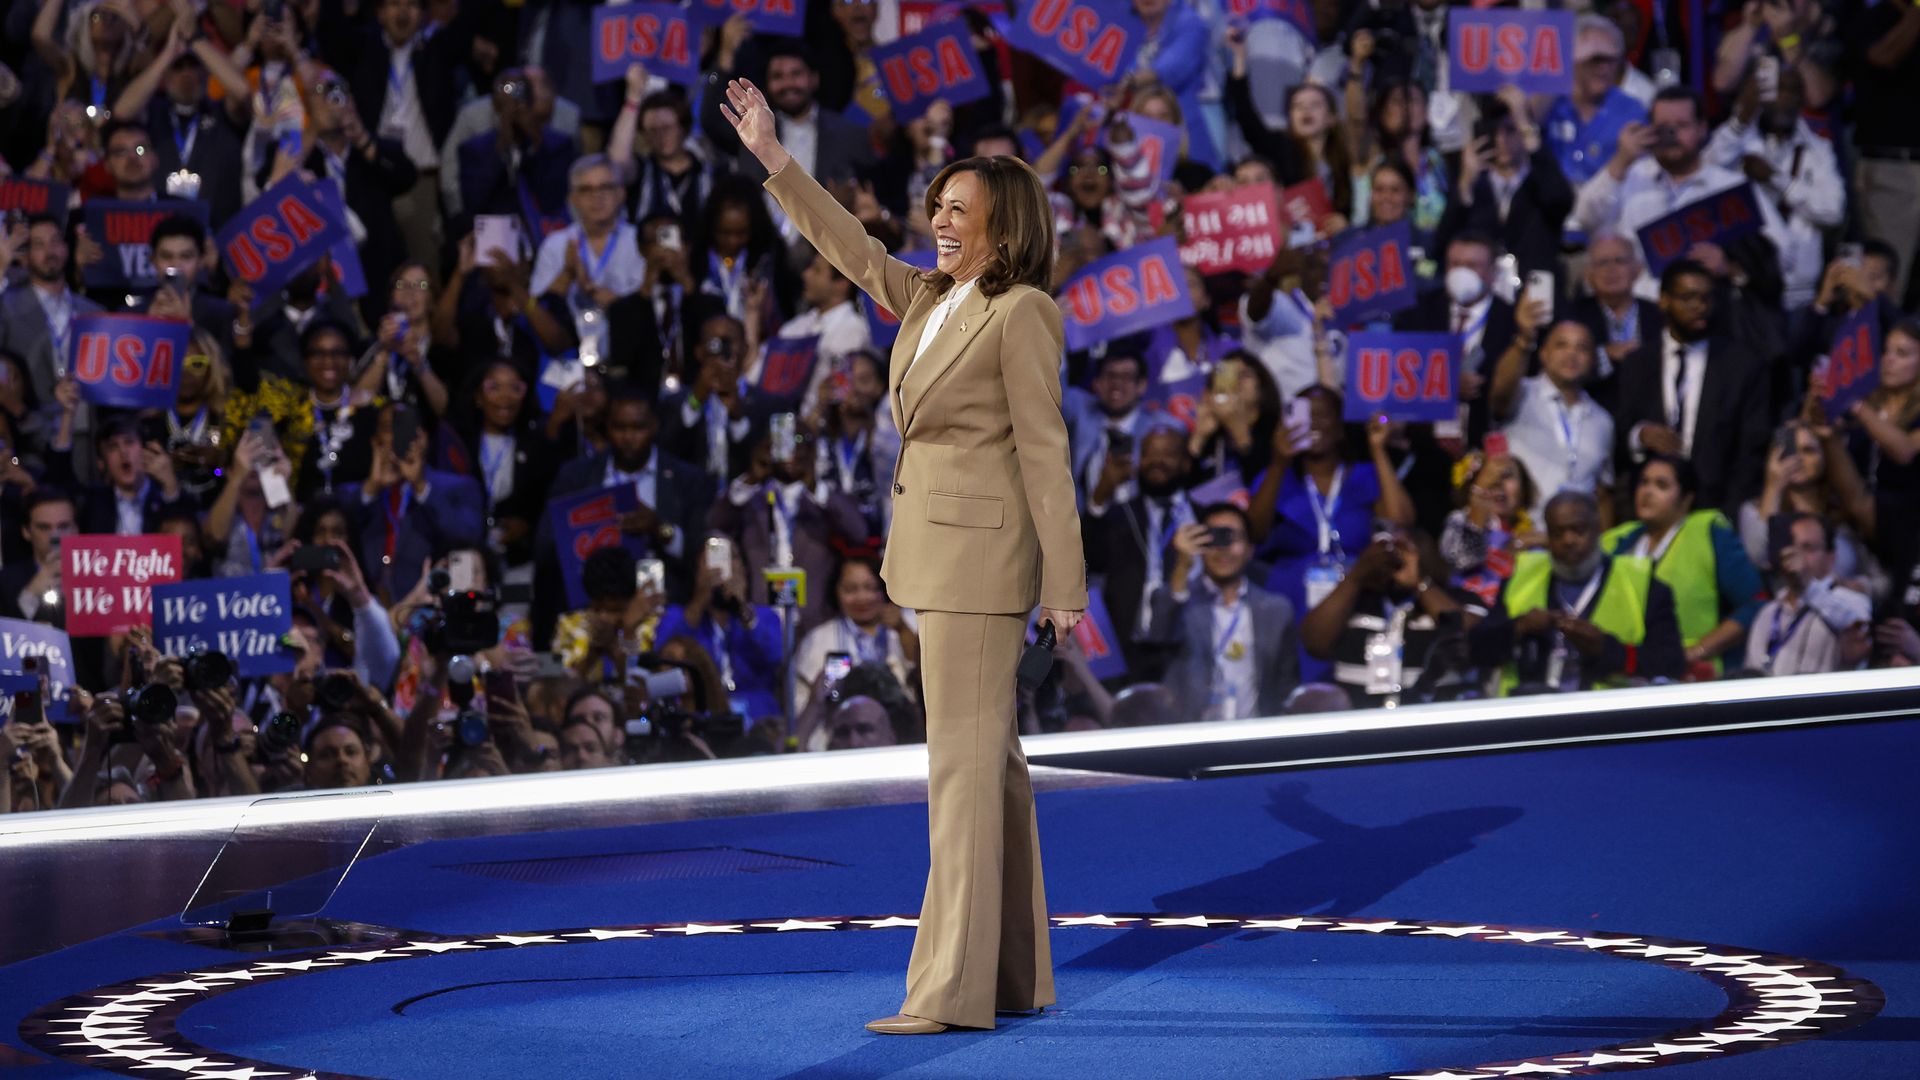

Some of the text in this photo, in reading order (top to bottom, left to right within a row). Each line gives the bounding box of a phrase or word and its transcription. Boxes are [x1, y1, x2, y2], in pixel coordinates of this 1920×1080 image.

[602, 14, 690, 66] USA
[1029, 0, 1129, 78] USA
[1458, 23, 1564, 76] USA
[883, 35, 974, 104] USA
[227, 194, 328, 282] USA
[1650, 194, 1752, 258] USA
[1067, 254, 1180, 326] USA
[1330, 240, 1406, 308] USA
[75, 331, 175, 389] USA
[1356, 348, 1451, 402] USA
[72, 548, 176, 583] We Fight,
[73, 586, 115, 616] We
[162, 590, 283, 626] We Vote,
